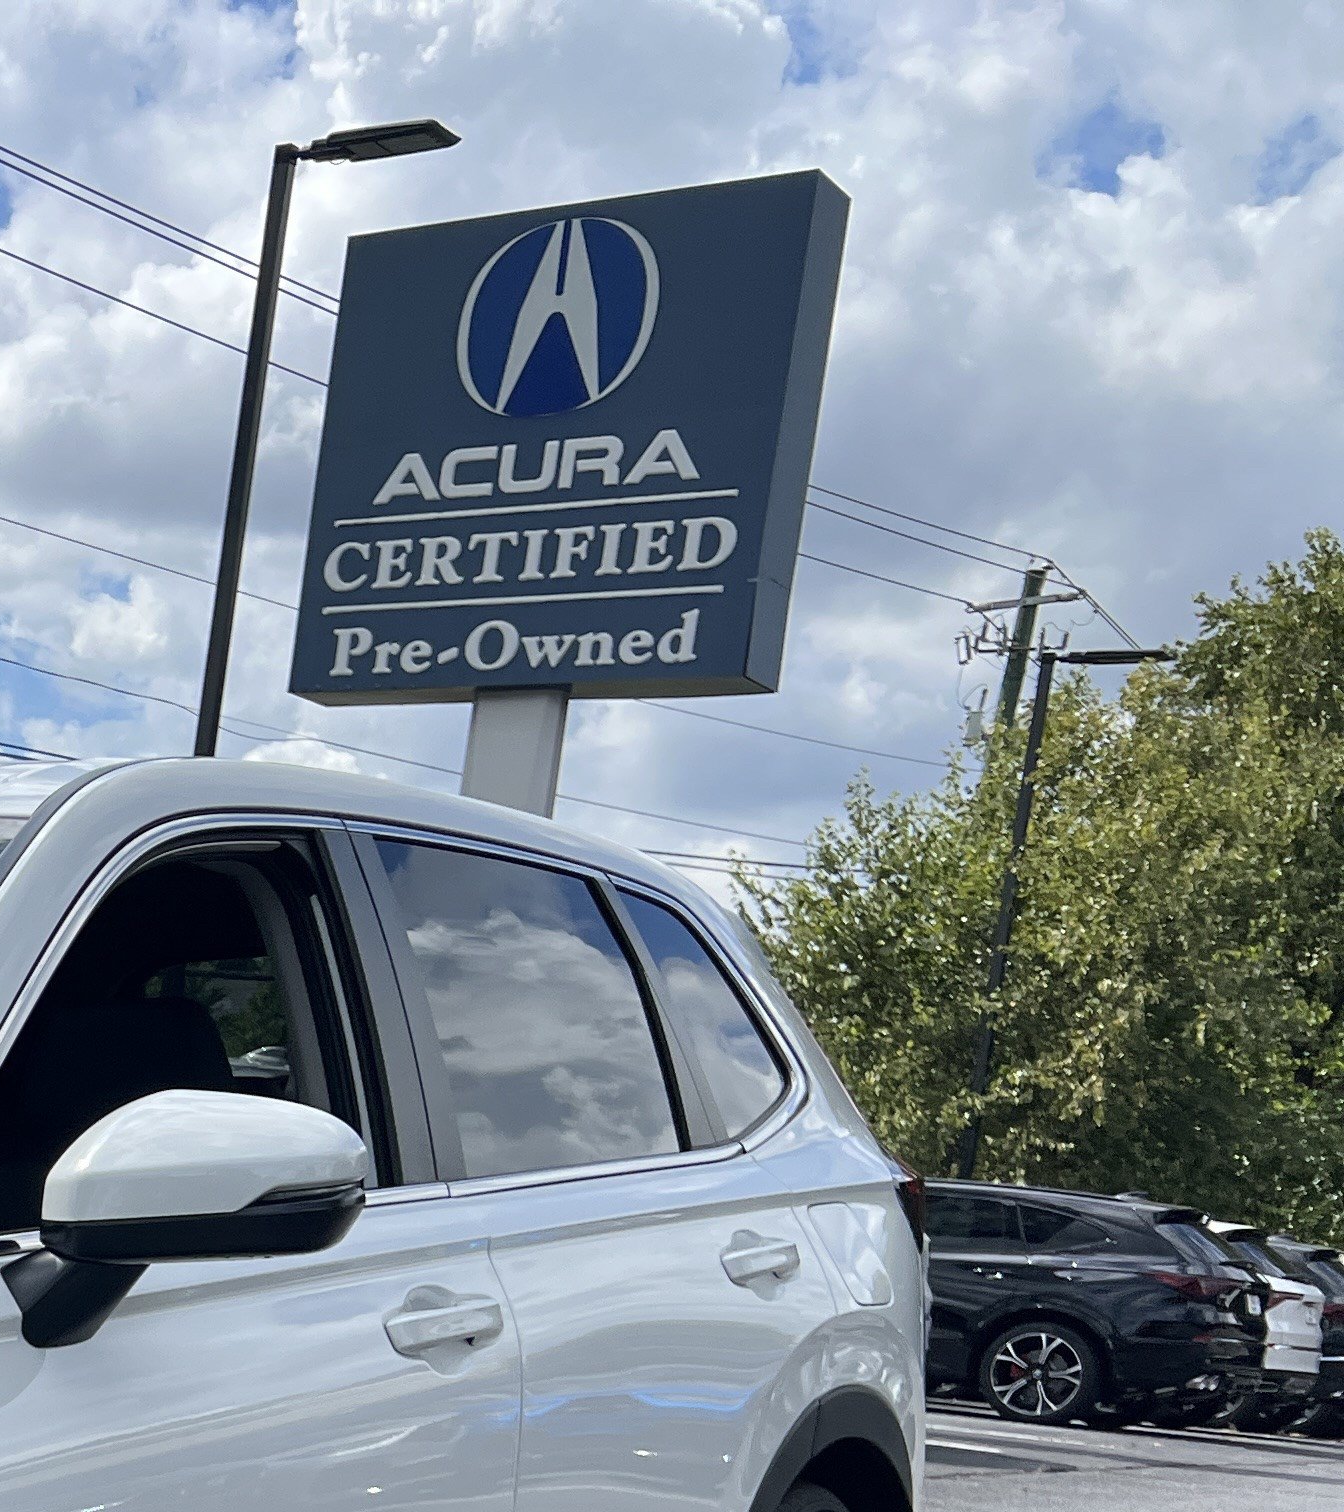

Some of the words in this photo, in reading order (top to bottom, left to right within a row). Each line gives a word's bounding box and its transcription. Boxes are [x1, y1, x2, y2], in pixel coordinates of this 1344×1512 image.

[372, 428, 700, 506] ACURA
[322, 516, 739, 592] CERTIFIED
[328, 608, 701, 677] Pre-Owned
